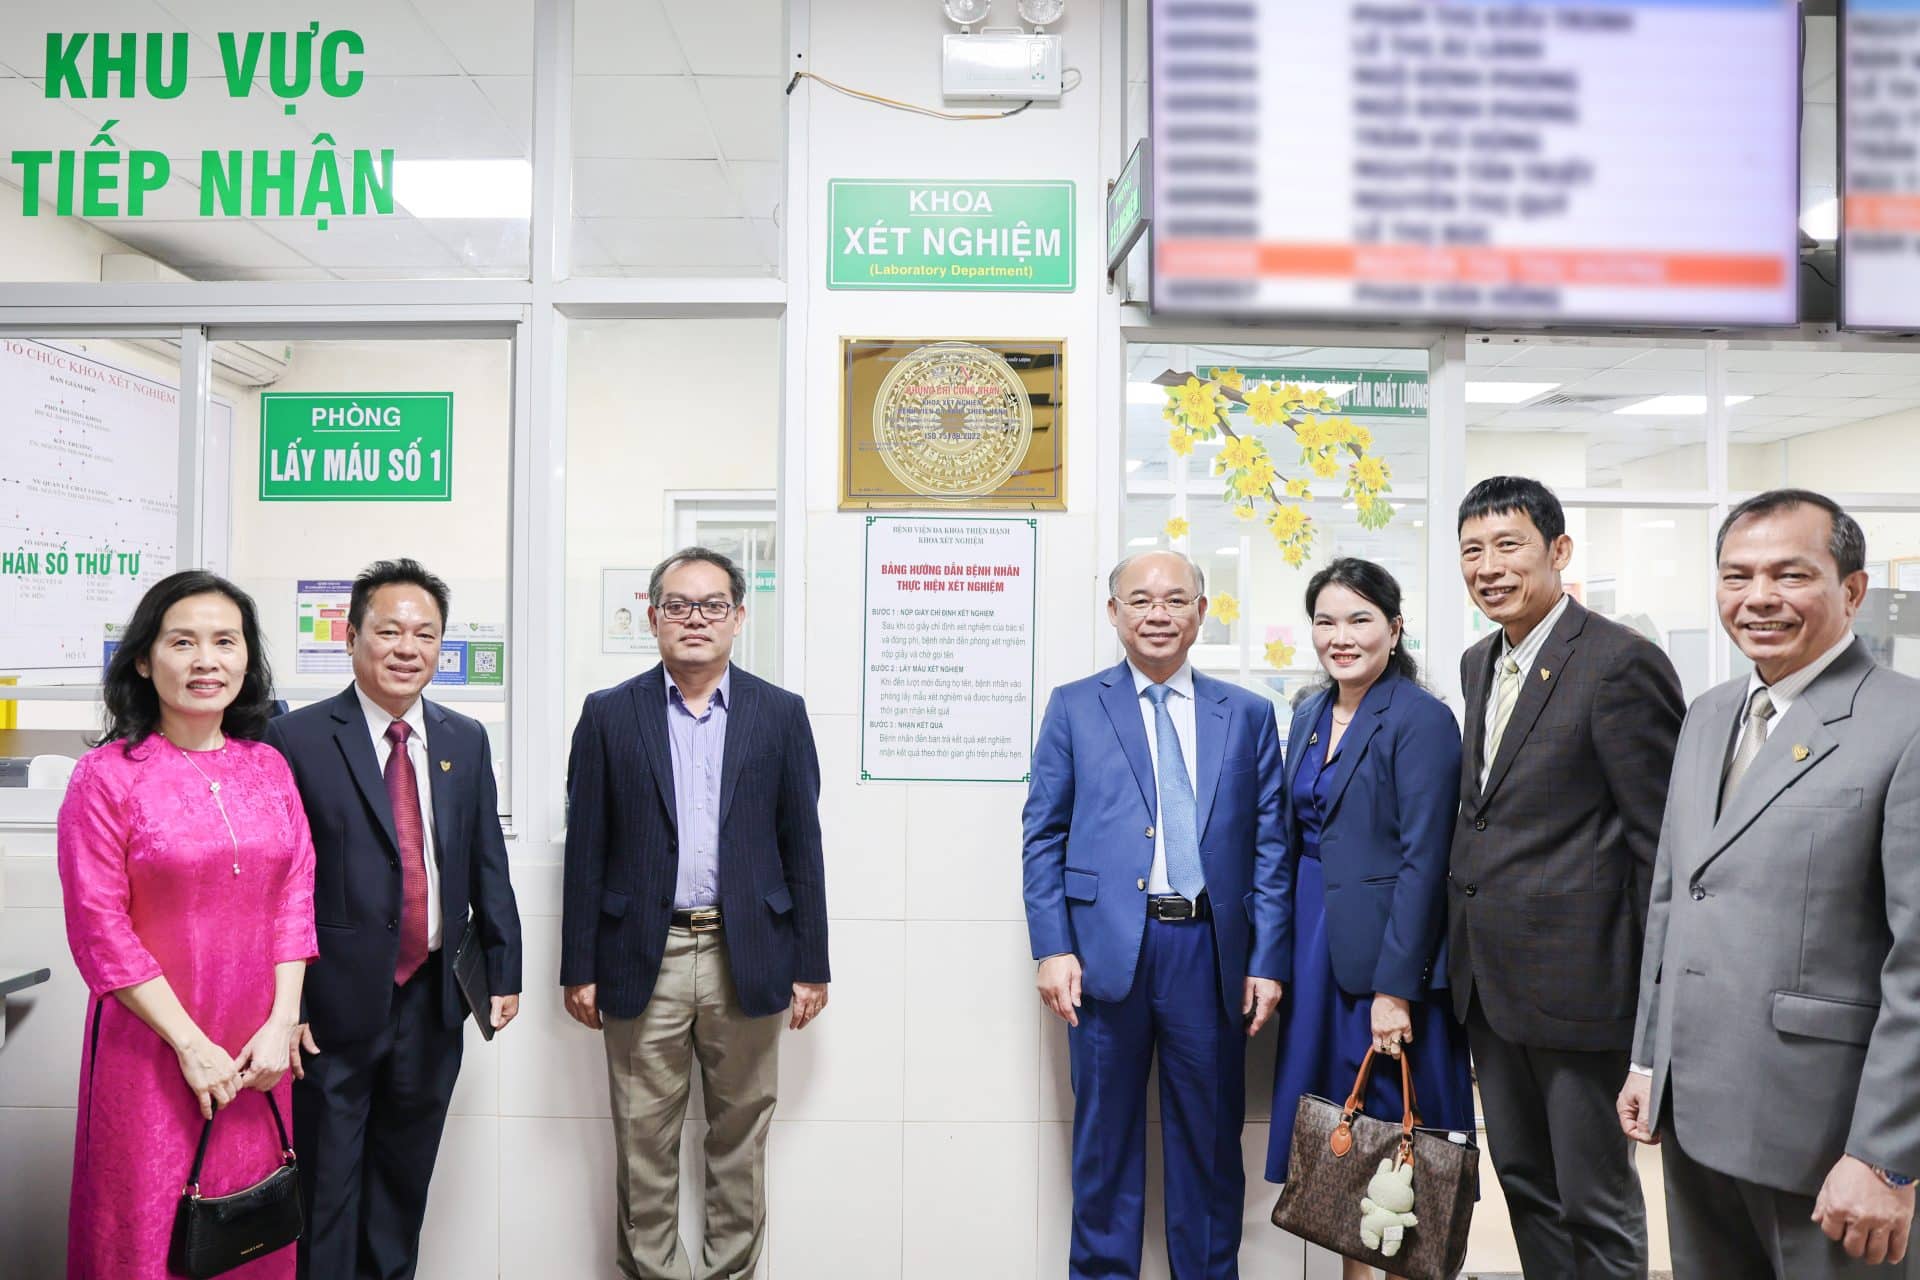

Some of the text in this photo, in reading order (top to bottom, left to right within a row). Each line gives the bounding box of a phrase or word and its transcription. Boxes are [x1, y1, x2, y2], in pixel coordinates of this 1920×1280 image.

[45, 21, 365, 115] KHU VỰC
[12, 120, 395, 230] TIẾP NHẬN
[909, 190, 993, 212] KHOA
[843, 220, 1061, 262] XÉT NGHIỆM
[869, 264, 1033, 278] (Laboratory Department)
[1373, 372, 1398, 409] CHẤT
[311, 401, 401, 427] PHÒNG
[271, 436, 441, 482] LẤY MÁU SỐ 1
[0, 547, 39, 580] HẬN
[45, 541, 69, 575] SỐ
[75, 544, 113, 576] THỨ
[117, 549, 142, 581] TỰ
[881, 561, 1020, 578] BẢNG HƯỚNG DẪN BỆNH NHÂN
[897, 579, 1004, 594] THỰC HIỆN XÉT NGHIỆM
